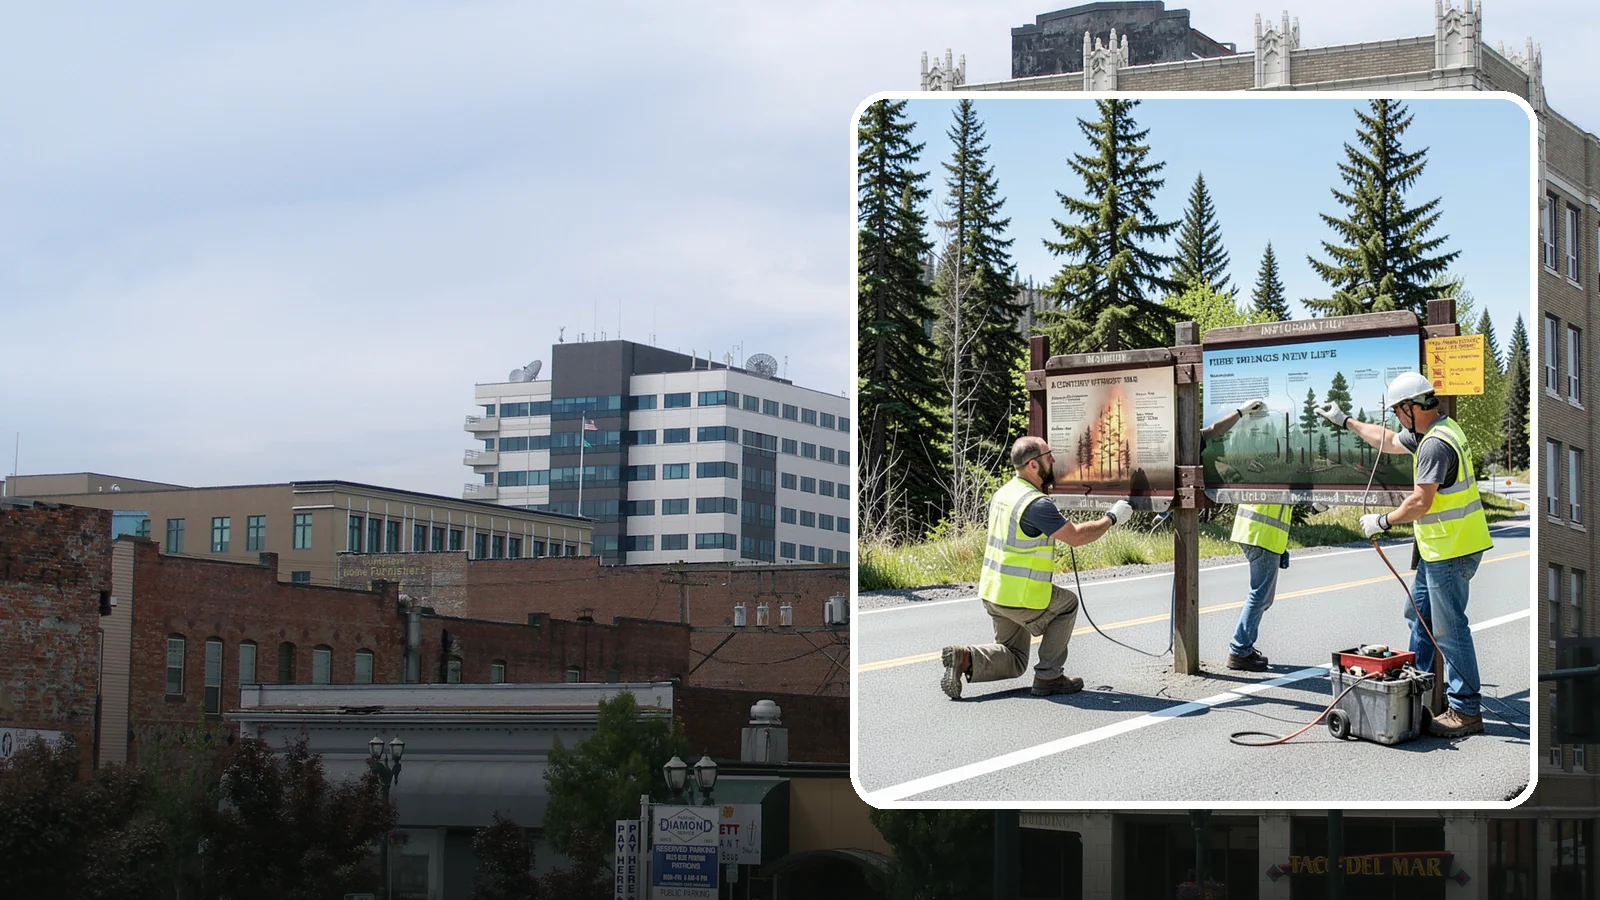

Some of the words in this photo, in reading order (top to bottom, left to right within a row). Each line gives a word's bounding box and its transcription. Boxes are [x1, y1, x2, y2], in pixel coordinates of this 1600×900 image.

[343, 567, 368, 577] Home
[370, 565, 427, 577] Furnishers
[660, 818, 713, 832] DIAMOND
[1021, 815, 1070, 828] BUILDING
[617, 825, 625, 852] PAY
[628, 824, 636, 852] PAY
[656, 845, 688, 853] RESERVED
[689, 846, 716, 854] PARKING
[722, 851, 739, 862] Soup
[671, 861, 701, 870] PATRONS
[1288, 855, 1331, 873] TAC
[1345, 856, 1385, 875] DEL
[1392, 857, 1443, 876] MAR
[616, 856, 625, 893] HERE
[628, 856, 636, 893] HERE
[660, 888, 682, 897] PUBLIC
[683, 889, 710, 898] PARKING
